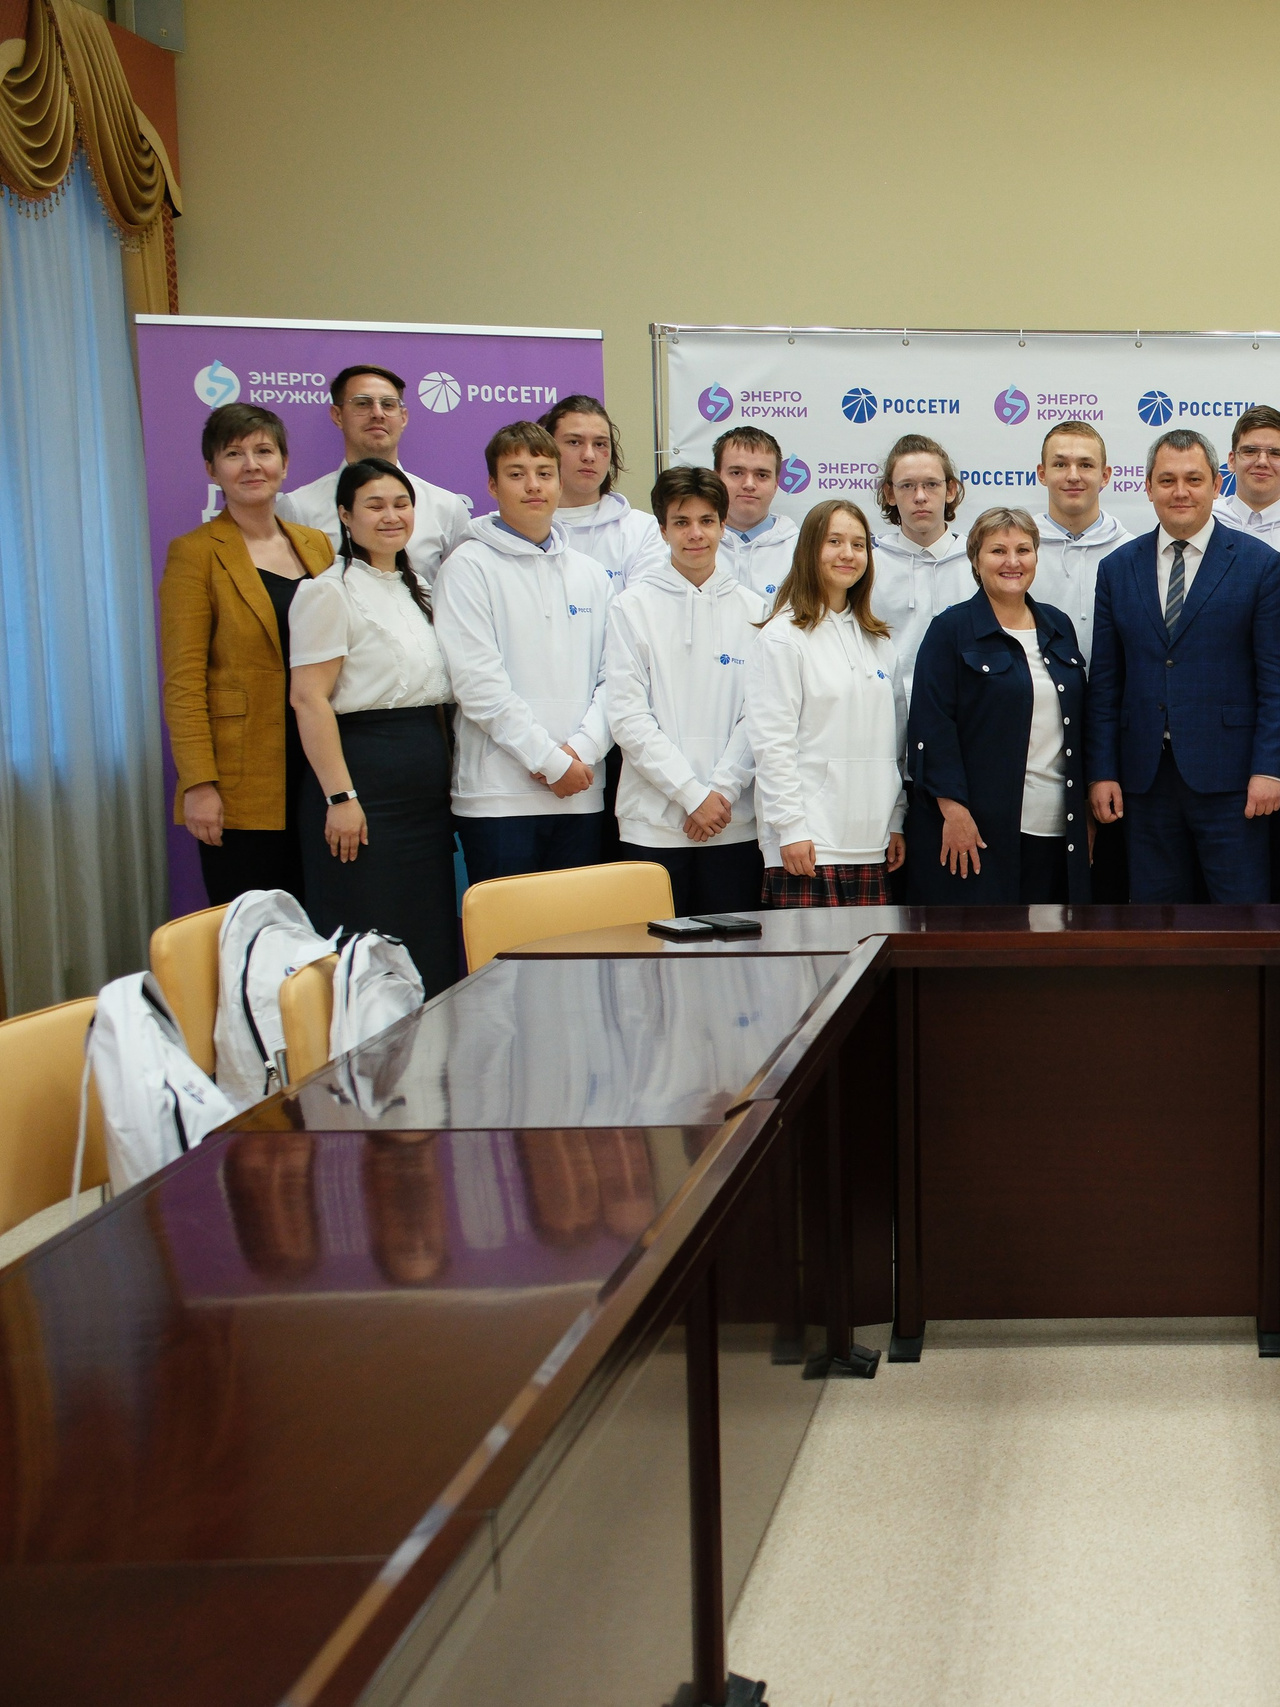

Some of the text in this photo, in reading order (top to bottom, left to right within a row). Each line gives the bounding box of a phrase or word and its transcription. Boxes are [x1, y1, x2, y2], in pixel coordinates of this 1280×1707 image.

[248, 371, 326, 387] ЭНЕРГО
[249, 389, 334, 405] КРУЖКИ
[467, 384, 558, 404] РОССЕТИ
[740, 390, 802, 402] ЭНЕРГО
[1037, 393, 1098, 406] ЭНЕРГО
[741, 406, 808, 418] КРУЖКИ
[883, 398, 960, 415] РОССЕТИ
[1037, 408, 1104, 421] КРУЖКИ
[818, 463, 879, 475] ЭНЕРГО
[960, 470, 1037, 486] РОССЕТИ
